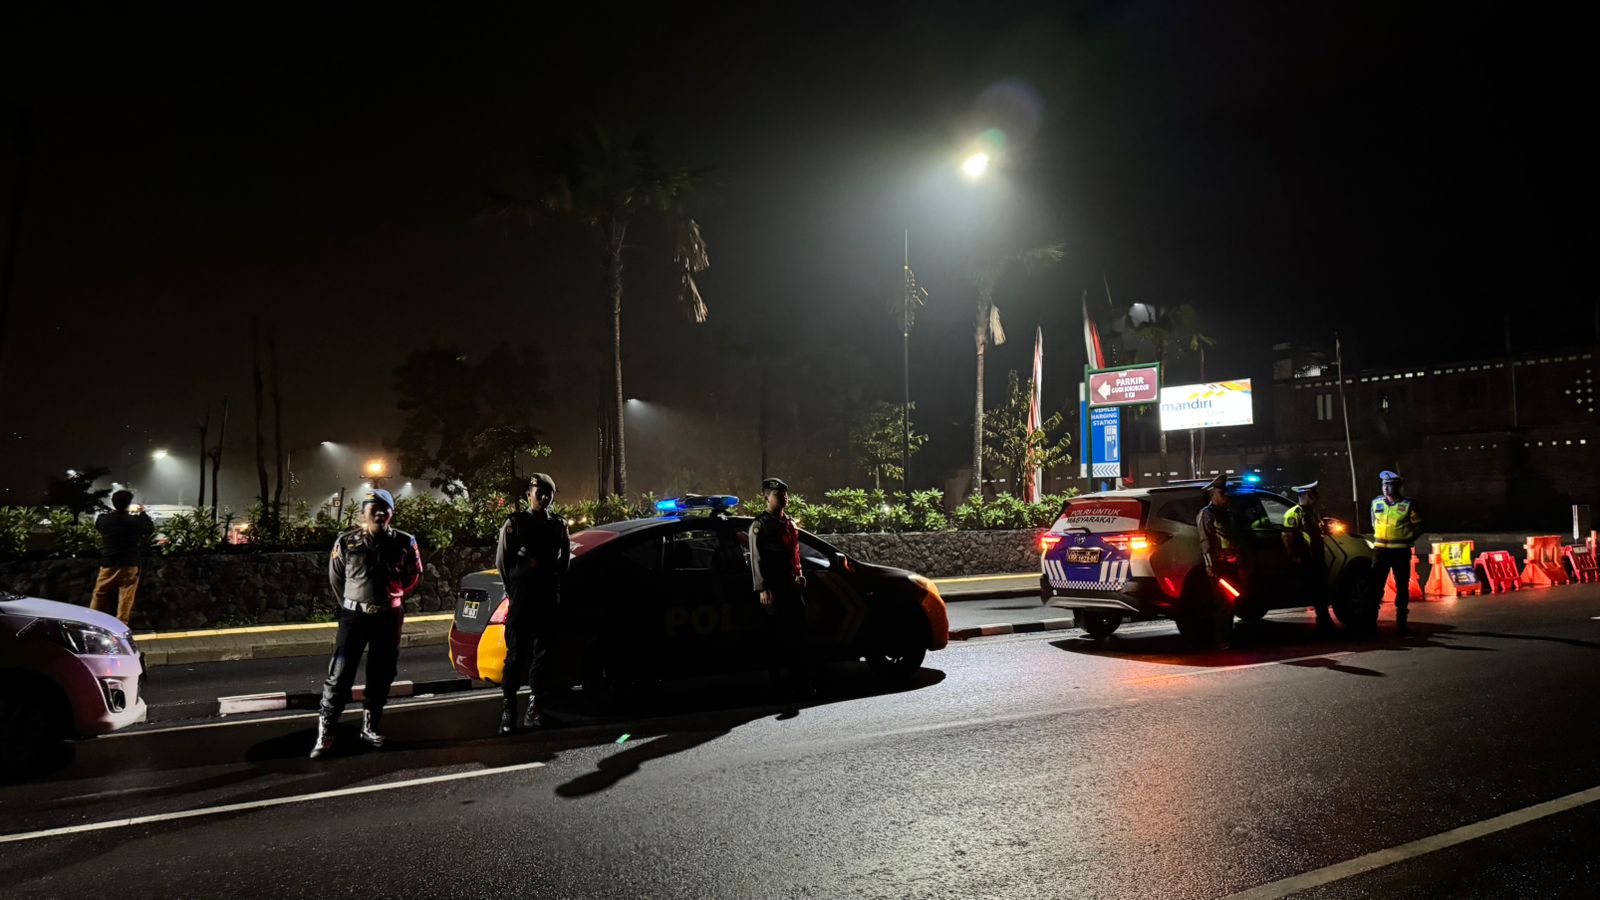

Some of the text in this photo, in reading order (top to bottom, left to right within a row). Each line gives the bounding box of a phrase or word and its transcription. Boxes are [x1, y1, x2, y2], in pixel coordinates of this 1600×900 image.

[1116, 376, 1144, 386] PARKIR
[1161, 398, 1212, 412] mandiri
[1091, 412, 1117, 420] HARGING
[1071, 508, 1121, 517] POLRI UNTUK
[1067, 516, 1117, 524] MASYARAKAT
[664, 603, 738, 641] POL
